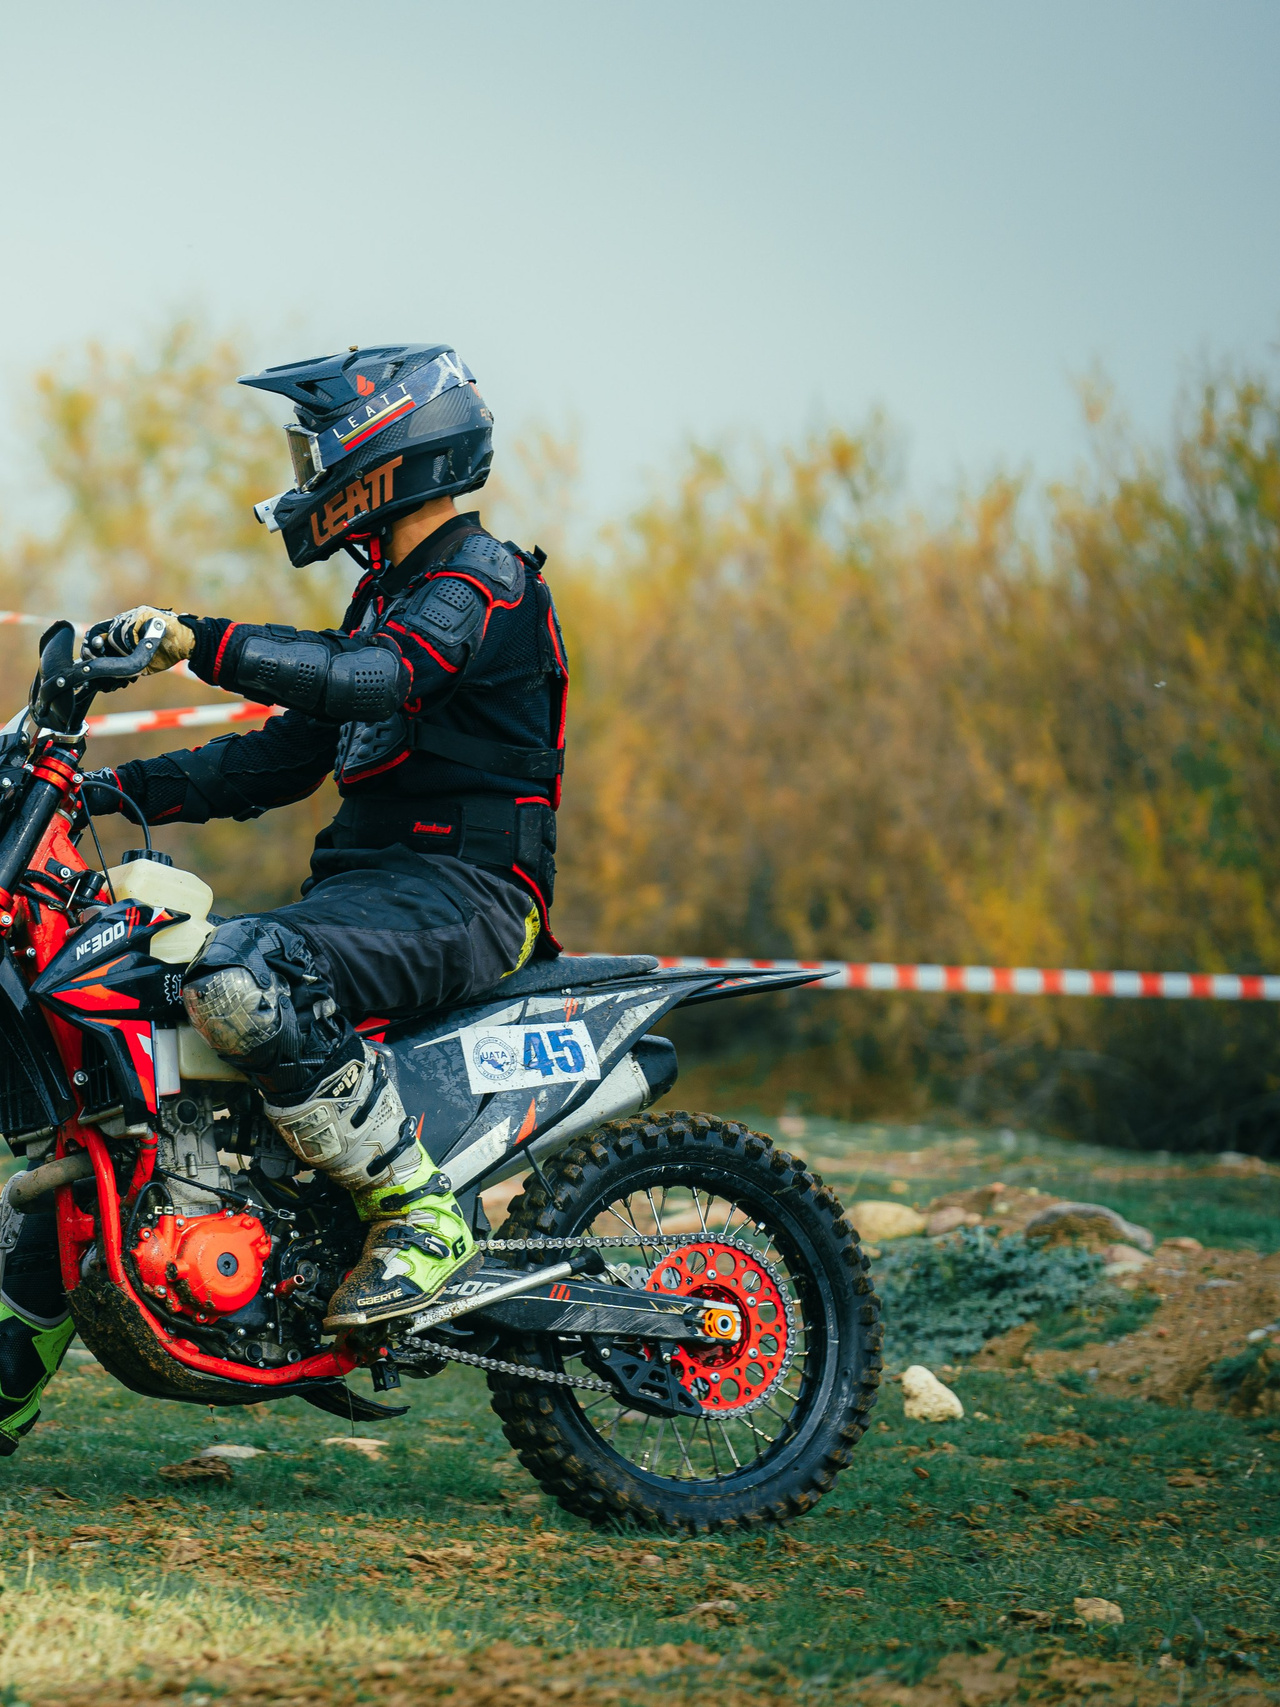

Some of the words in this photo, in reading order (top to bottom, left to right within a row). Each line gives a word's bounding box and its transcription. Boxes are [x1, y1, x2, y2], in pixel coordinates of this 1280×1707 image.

[332, 383, 408, 439] LEATT
[310, 454, 404, 547] LEATT
[75, 920, 126, 961] NC300
[481, 1051, 508, 1060] UATA
[523, 1028, 586, 1077] 45
[451, 1235, 466, 1260] G
